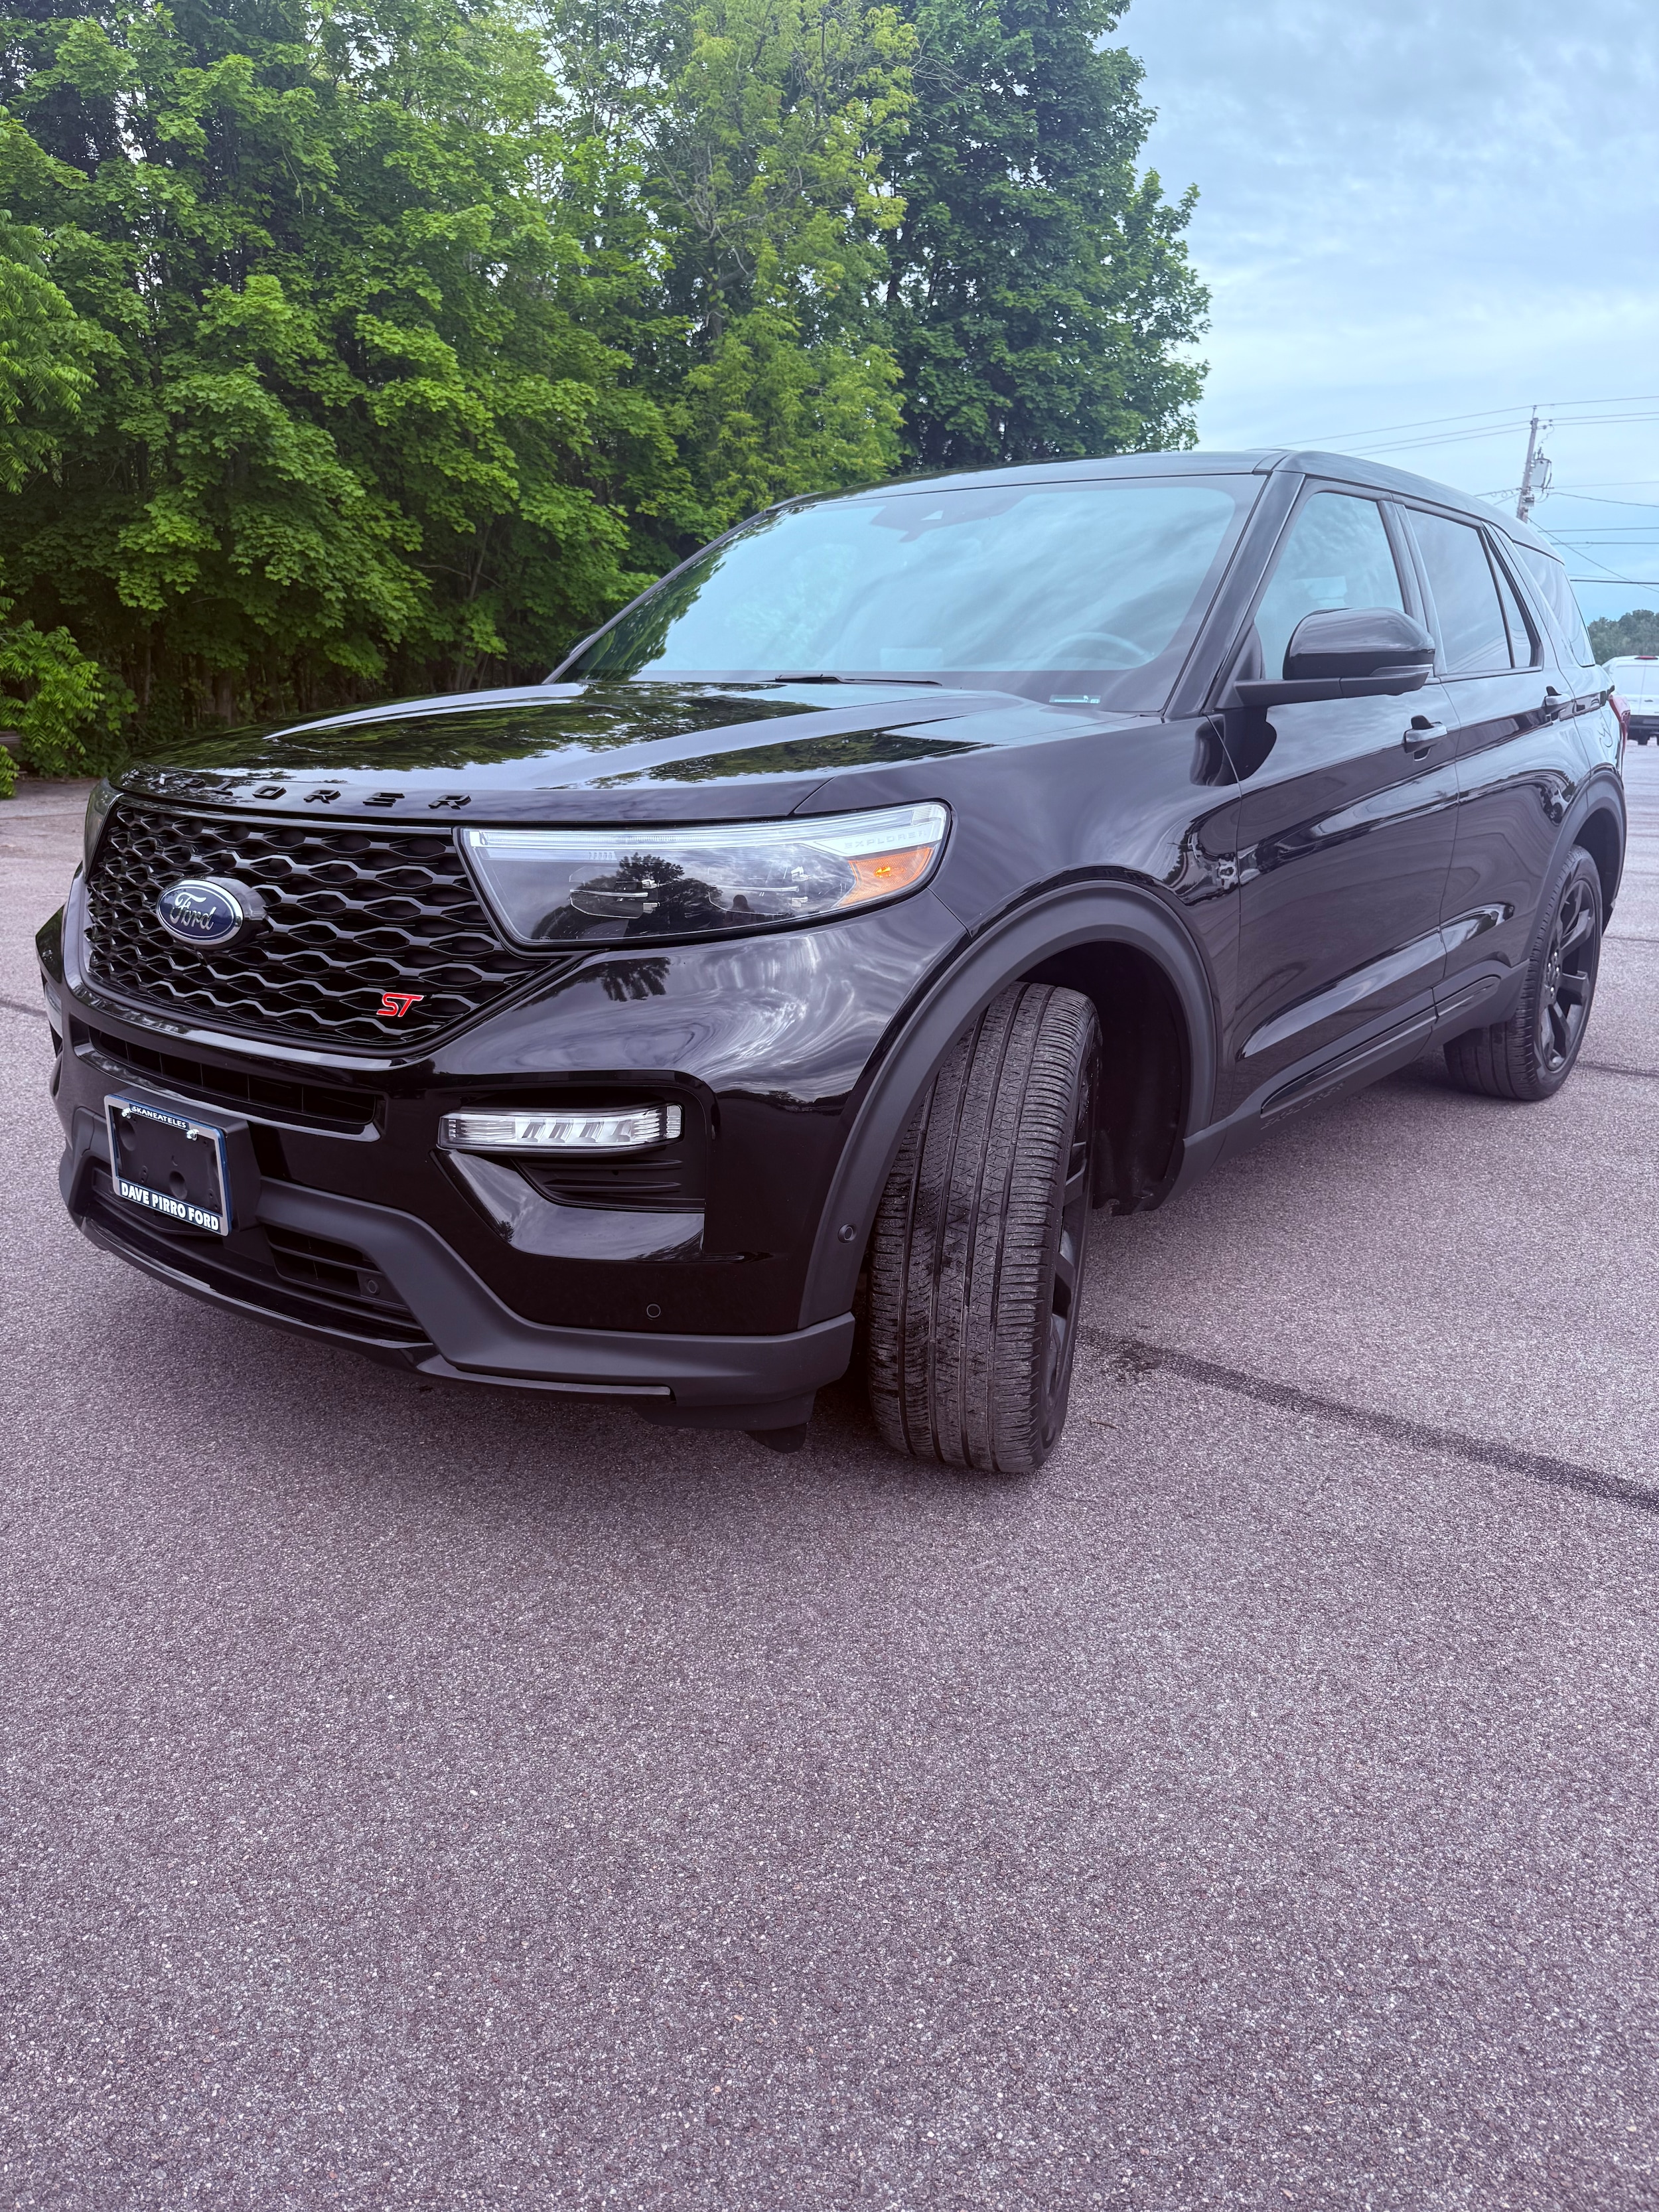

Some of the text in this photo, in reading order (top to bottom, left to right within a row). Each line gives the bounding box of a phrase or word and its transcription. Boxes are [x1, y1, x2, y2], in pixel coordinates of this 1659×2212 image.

[844, 830, 926, 849] EXPLORER
[169, 891, 217, 930] Ford
[376, 992, 425, 1017] ST
[132, 1106, 186, 1129] SKANEATELES
[121, 1182, 219, 1231] DAVE PIRRO FORD
